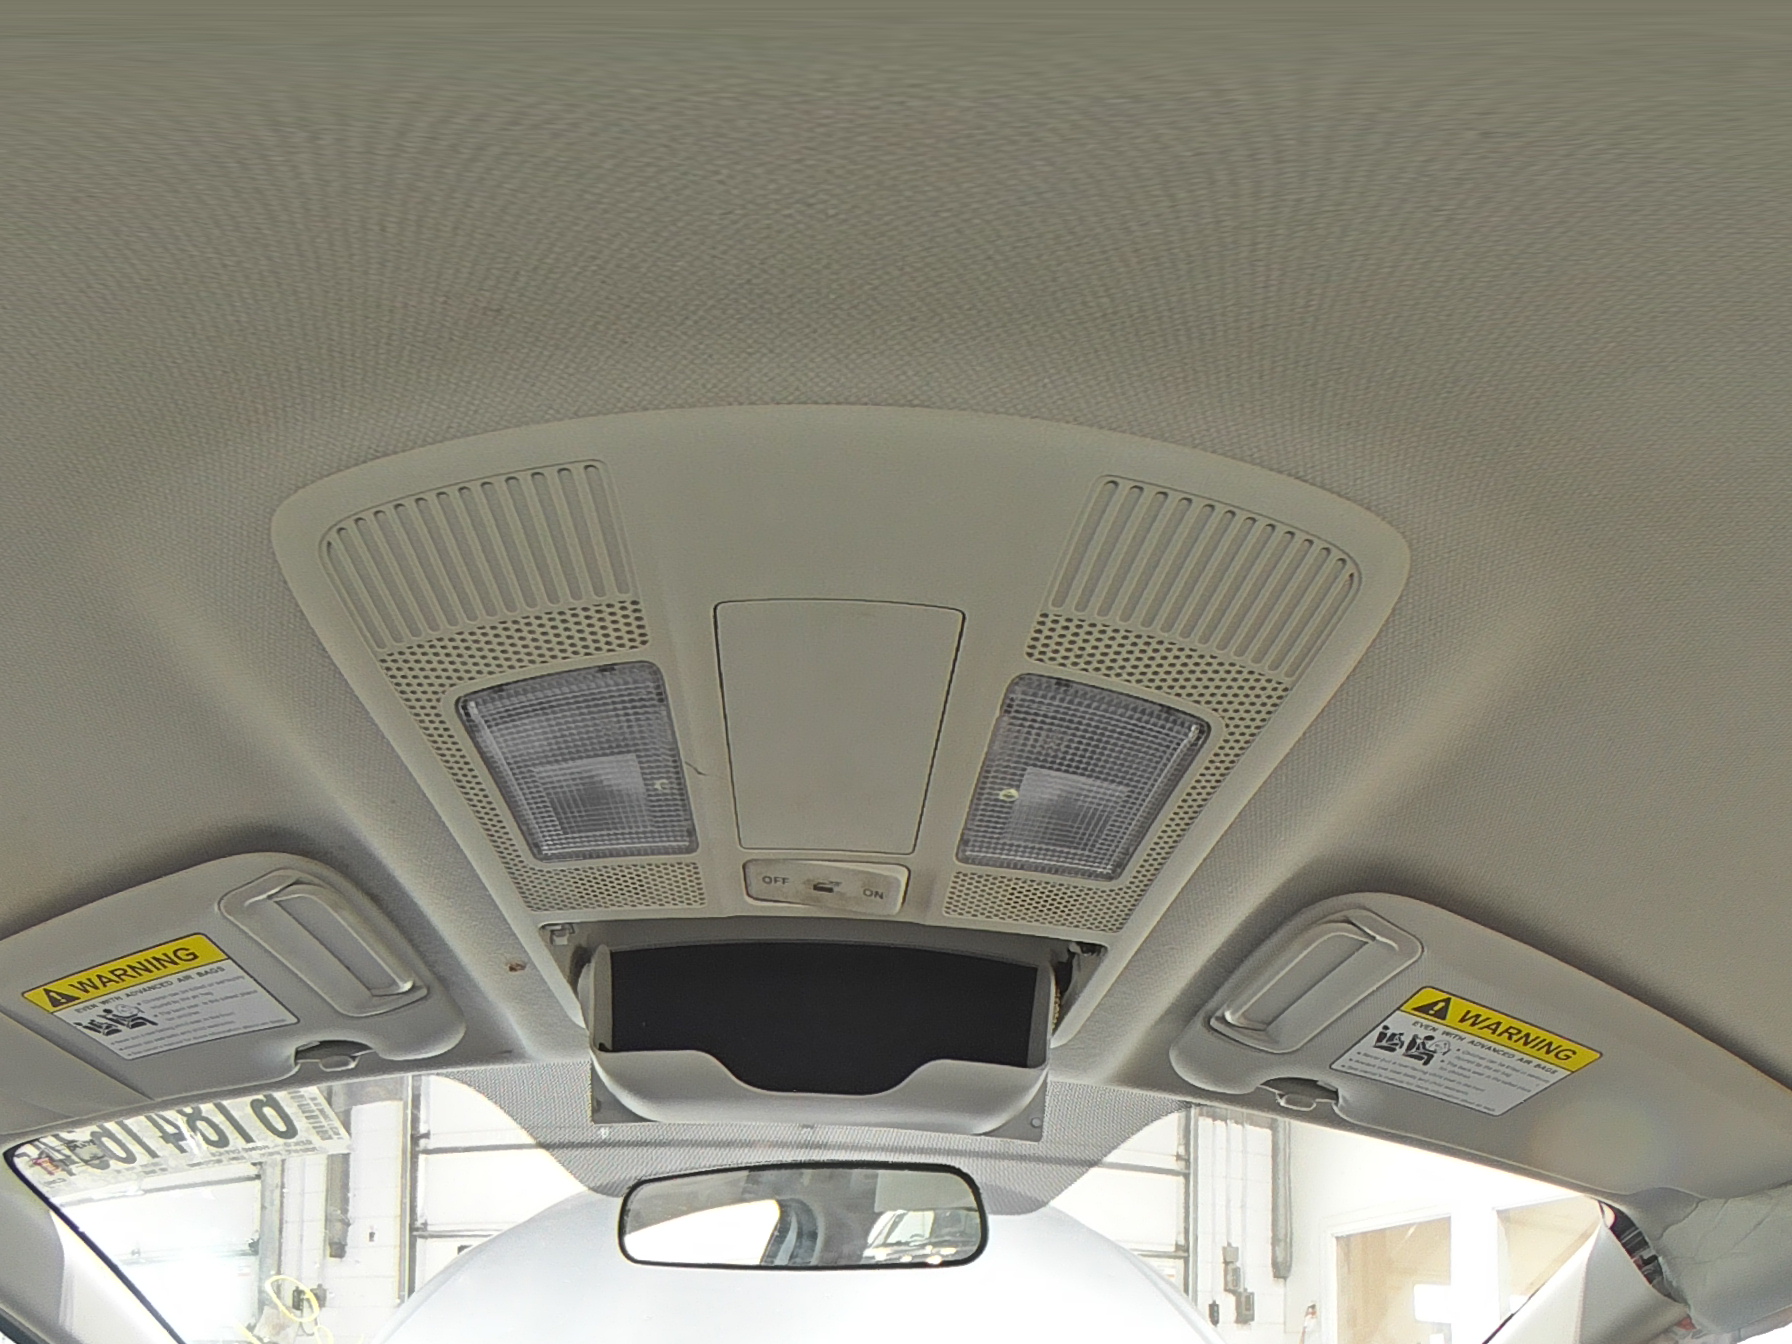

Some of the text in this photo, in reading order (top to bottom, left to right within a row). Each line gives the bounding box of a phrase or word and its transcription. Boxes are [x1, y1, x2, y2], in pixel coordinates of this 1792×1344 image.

[762, 875, 790, 885] OFF
[862, 887, 885, 900] ON
[69, 947, 200, 994] WARNING
[74, 965, 226, 1014] EVEN WITH ADVANCED AIR BAGS
[1412, 1020, 1559, 1076] EVEN WITH ADVANCED AIR BAGS
[1458, 1009, 1578, 1062] WARNING
